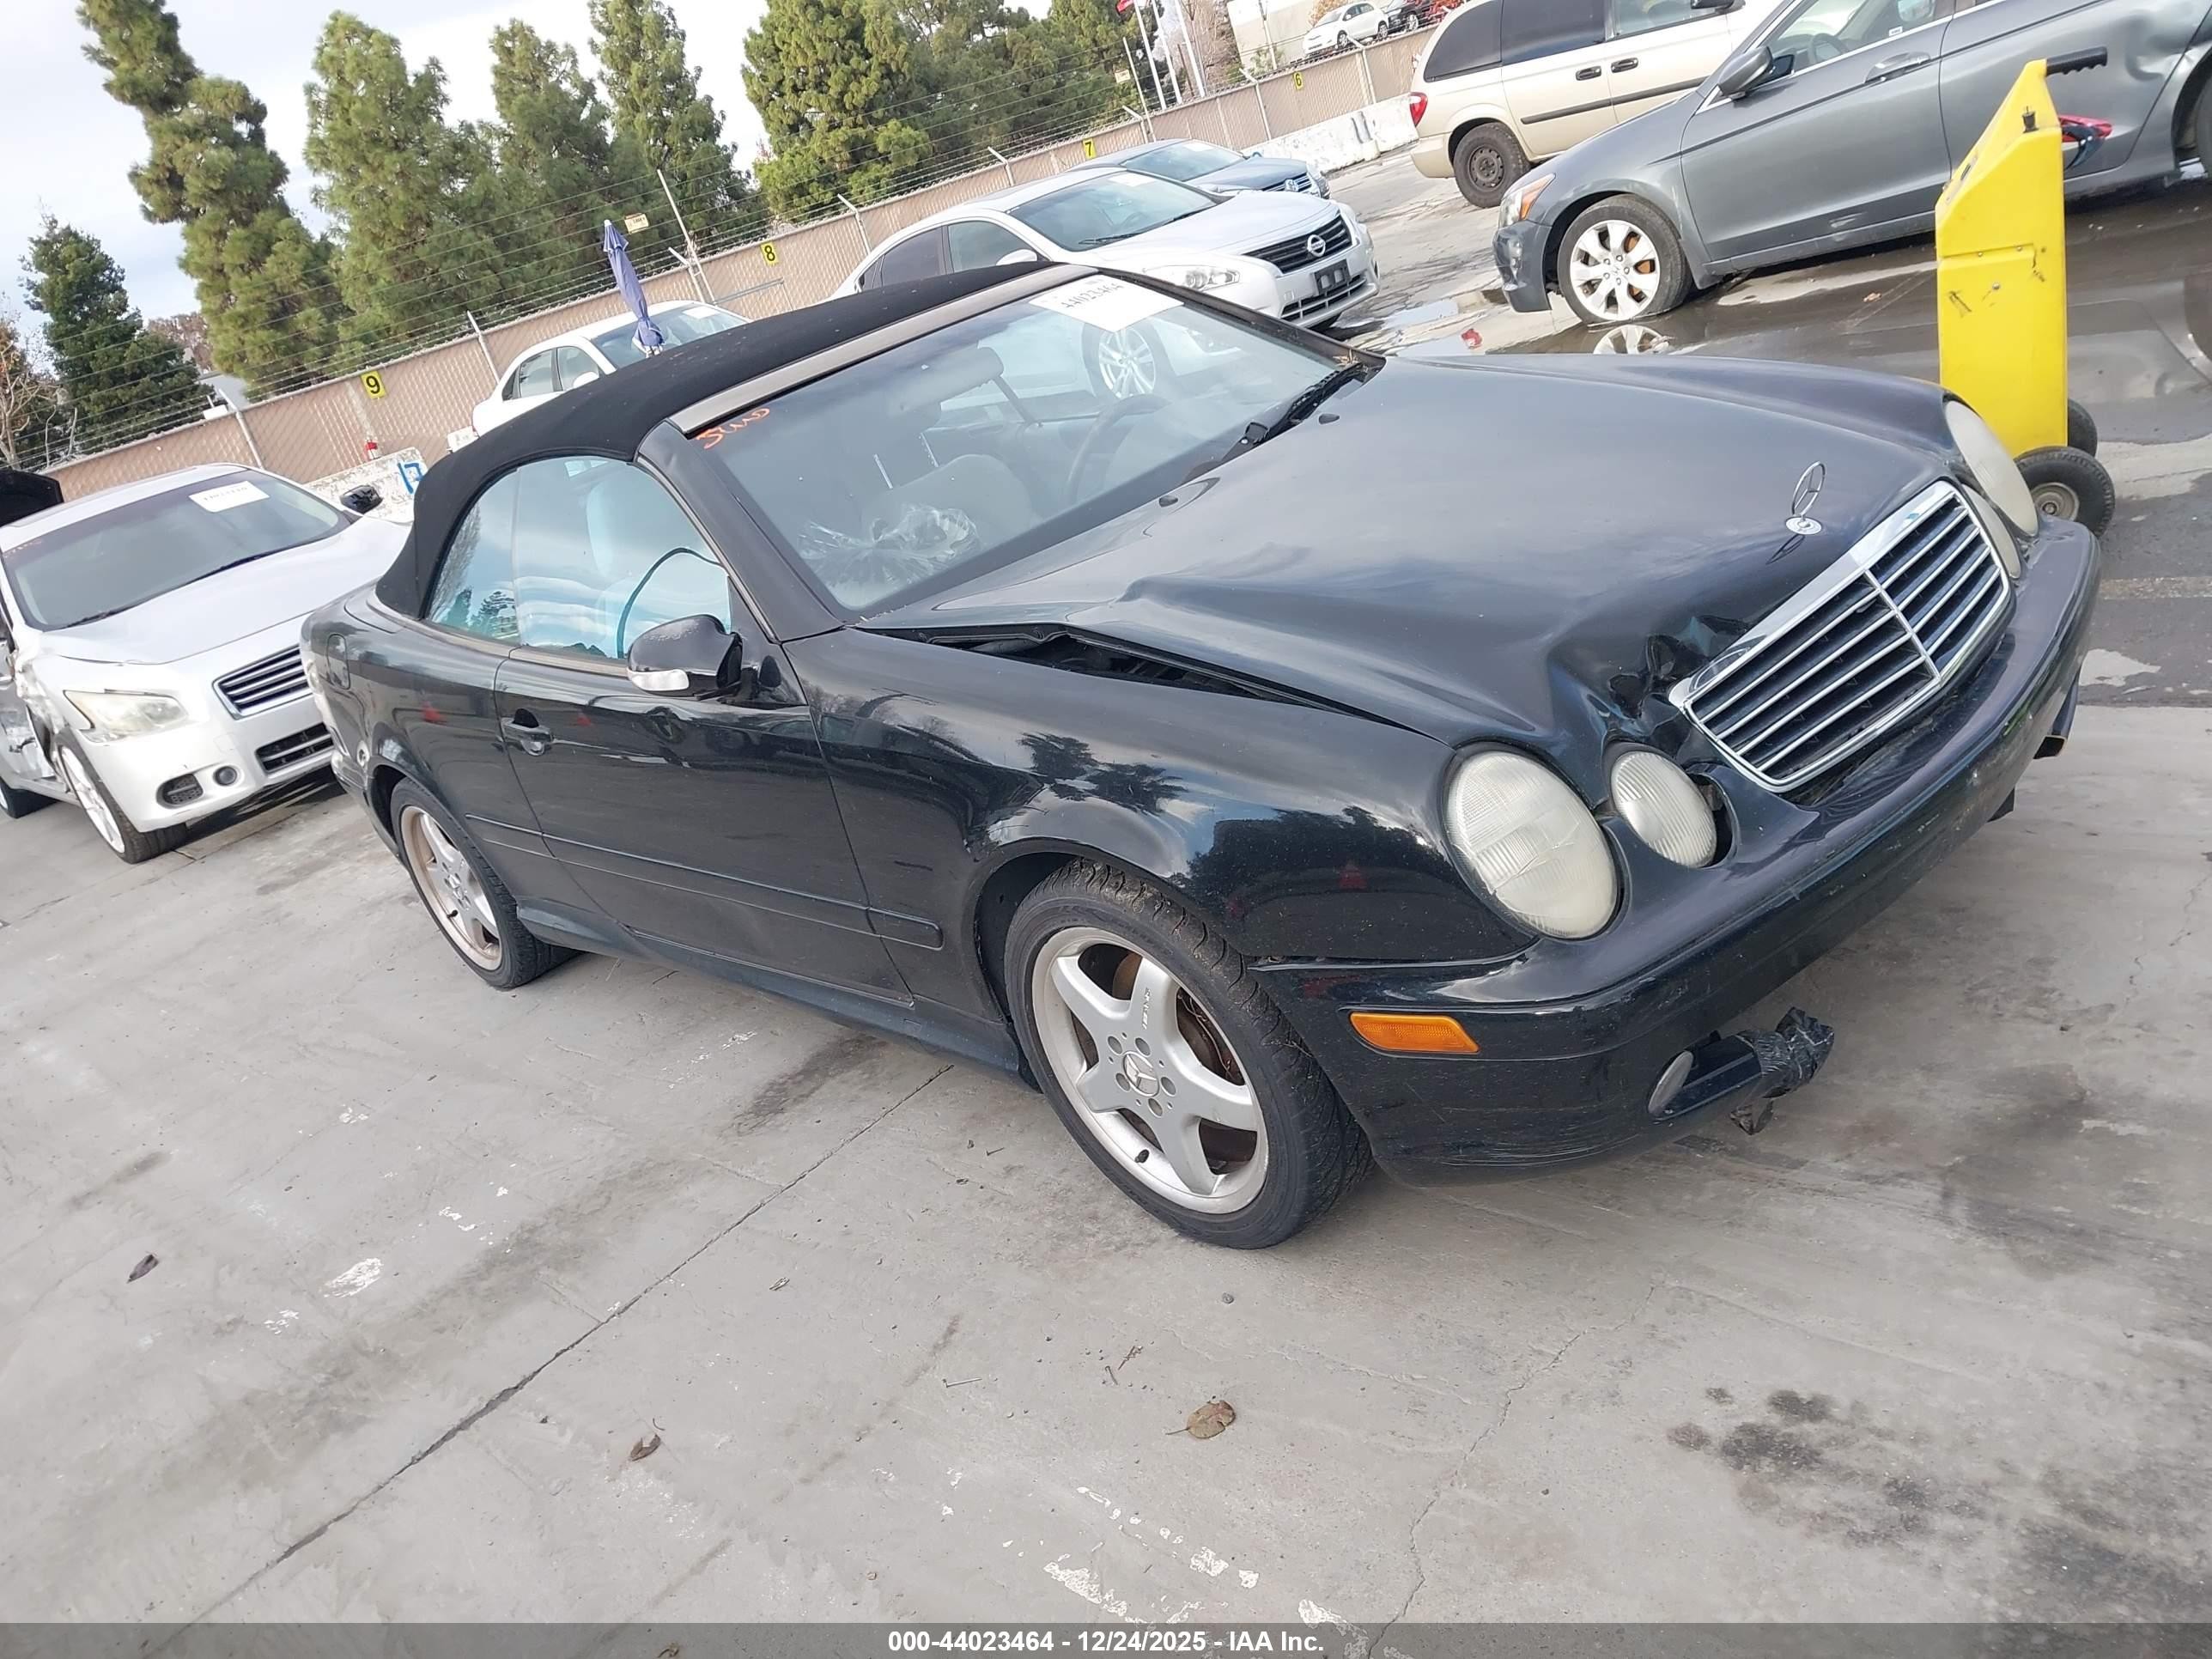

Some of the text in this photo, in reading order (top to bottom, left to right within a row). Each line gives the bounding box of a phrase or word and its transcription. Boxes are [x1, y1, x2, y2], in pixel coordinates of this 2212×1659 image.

[1295, 72, 1302, 87] 6
[1085, 141, 1092, 156] 7
[764, 245, 775, 261] 8
[366, 375, 380, 394] 9
